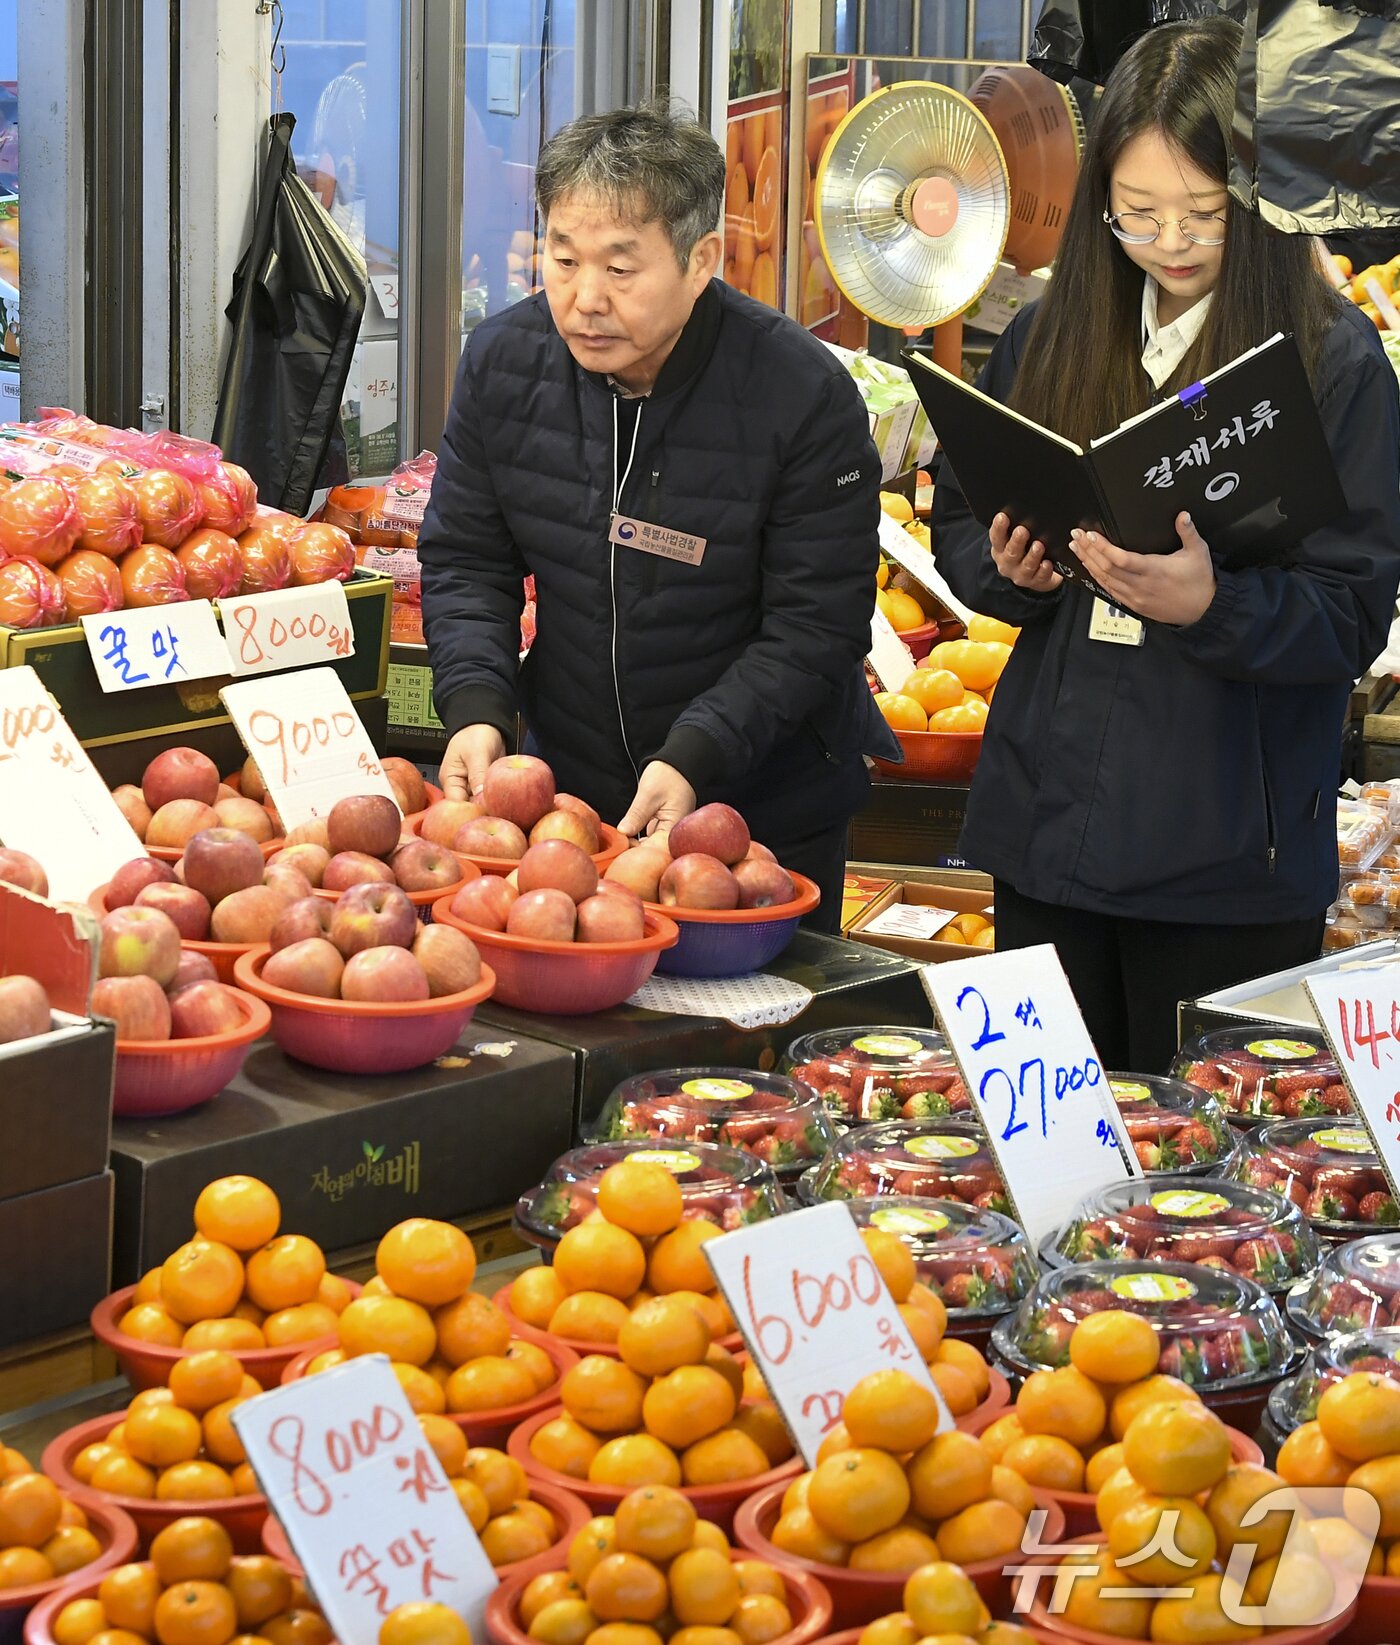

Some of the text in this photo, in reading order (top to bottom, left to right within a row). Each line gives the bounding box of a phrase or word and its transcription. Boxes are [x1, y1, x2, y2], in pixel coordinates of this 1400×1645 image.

[1143, 400, 1280, 488] 결재서류
[837, 470, 860, 487] NAQS
[641, 526, 697, 551] 특별사법경찰
